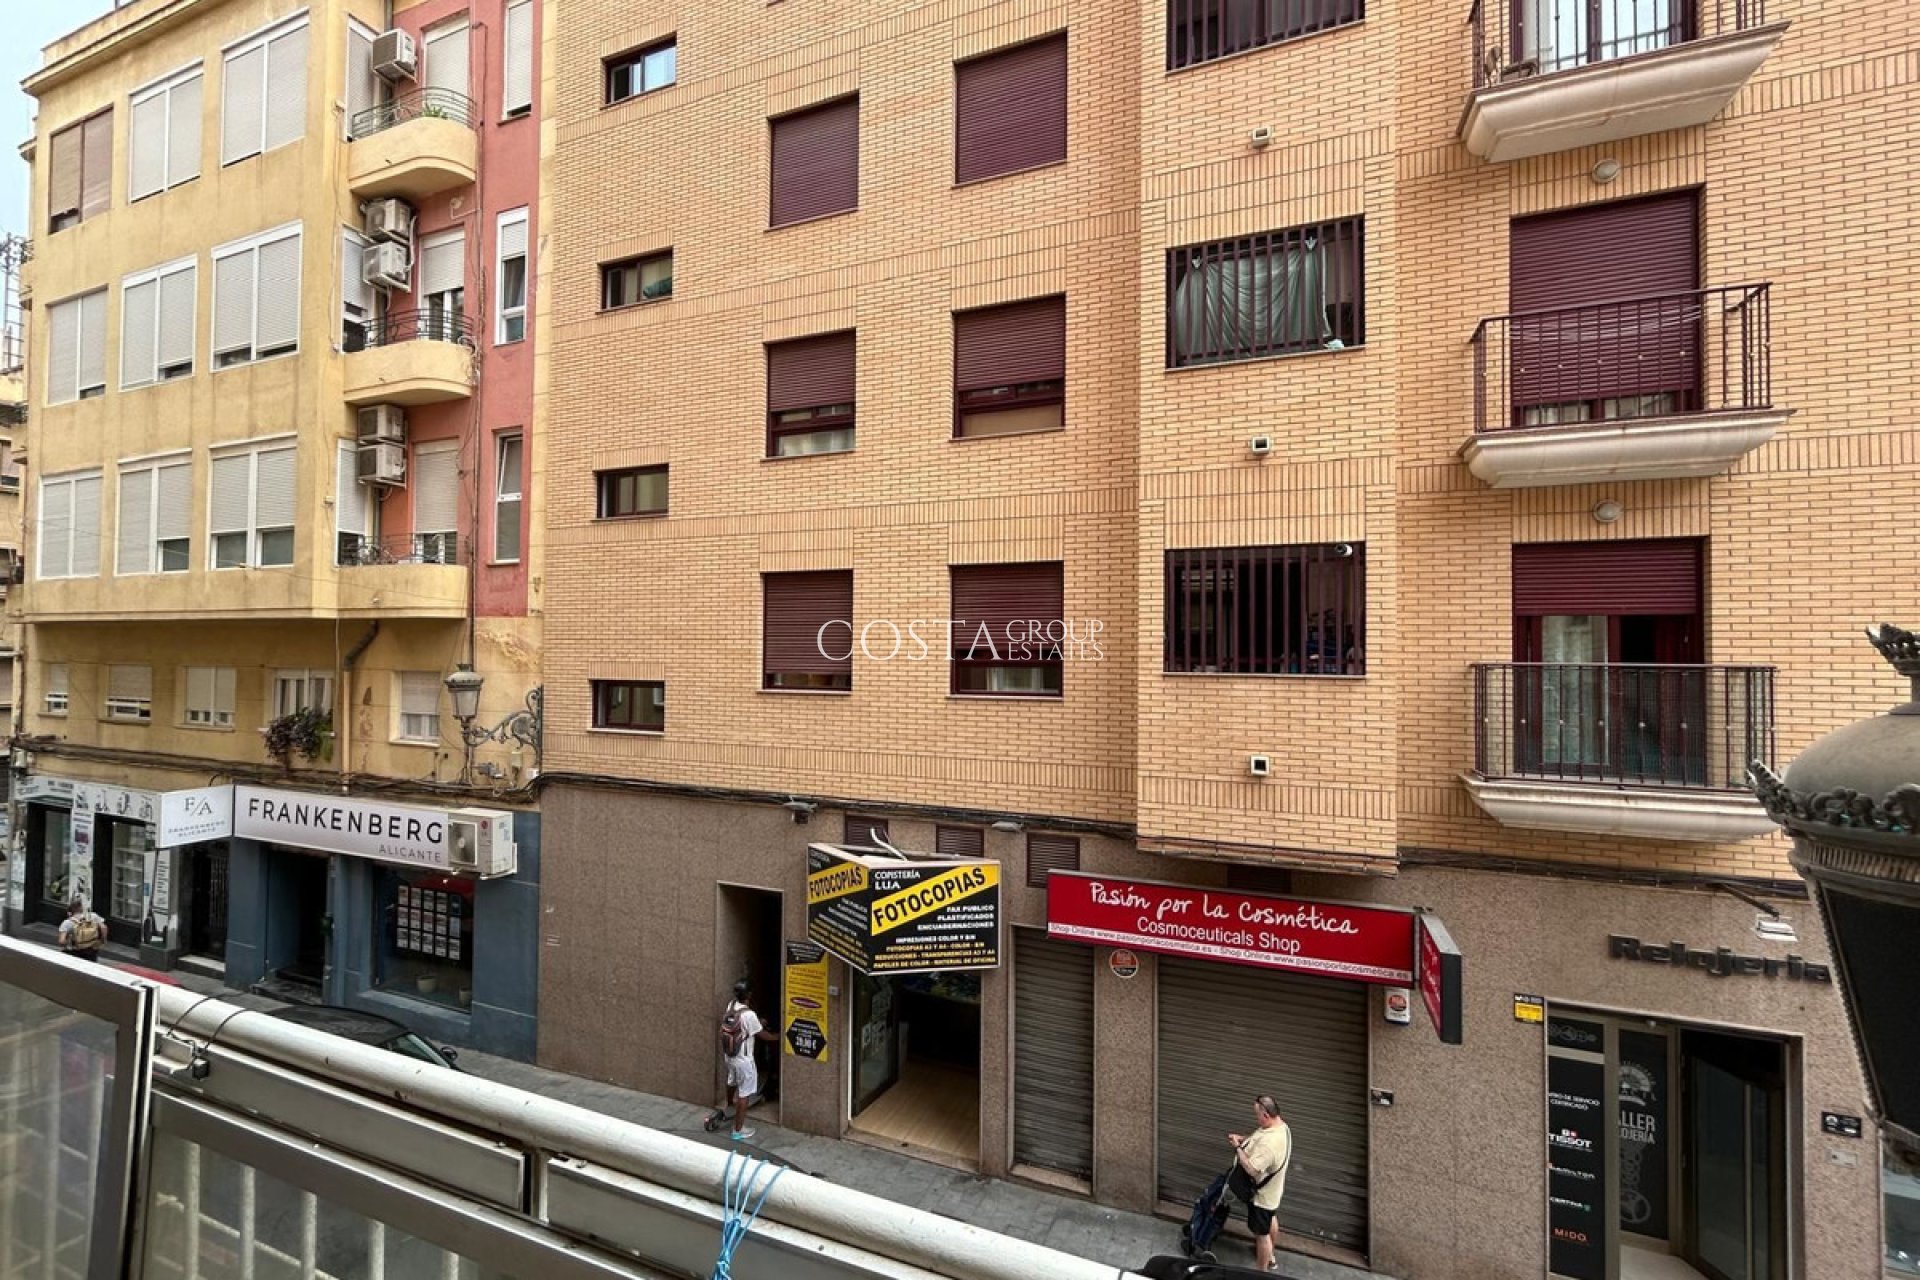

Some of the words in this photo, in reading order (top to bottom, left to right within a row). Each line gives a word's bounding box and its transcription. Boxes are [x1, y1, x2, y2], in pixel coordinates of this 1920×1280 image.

[248, 797, 443, 844] FRANKENBERG
[378, 844, 442, 863] ALICANTE
[809, 866, 863, 899] FOTOCOPIAS
[873, 867, 986, 927] FOTOCOPIAS
[875, 881, 901, 890] LUA
[1089, 882, 1151, 910] Pasión
[1157, 898, 1193, 920] por
[1202, 893, 1230, 918] la
[1239, 901, 1359, 934] Cosmética
[1050, 924, 1070, 934] Shop
[1220, 948, 1241, 957] Shop
[1243, 951, 1271, 961] Online
[1137, 917, 1254, 947] Cosmoceuticals
[1259, 931, 1301, 954] Shop
[1548, 1132, 1593, 1148] TISSOT
[1554, 1228, 1588, 1242] MIDO
